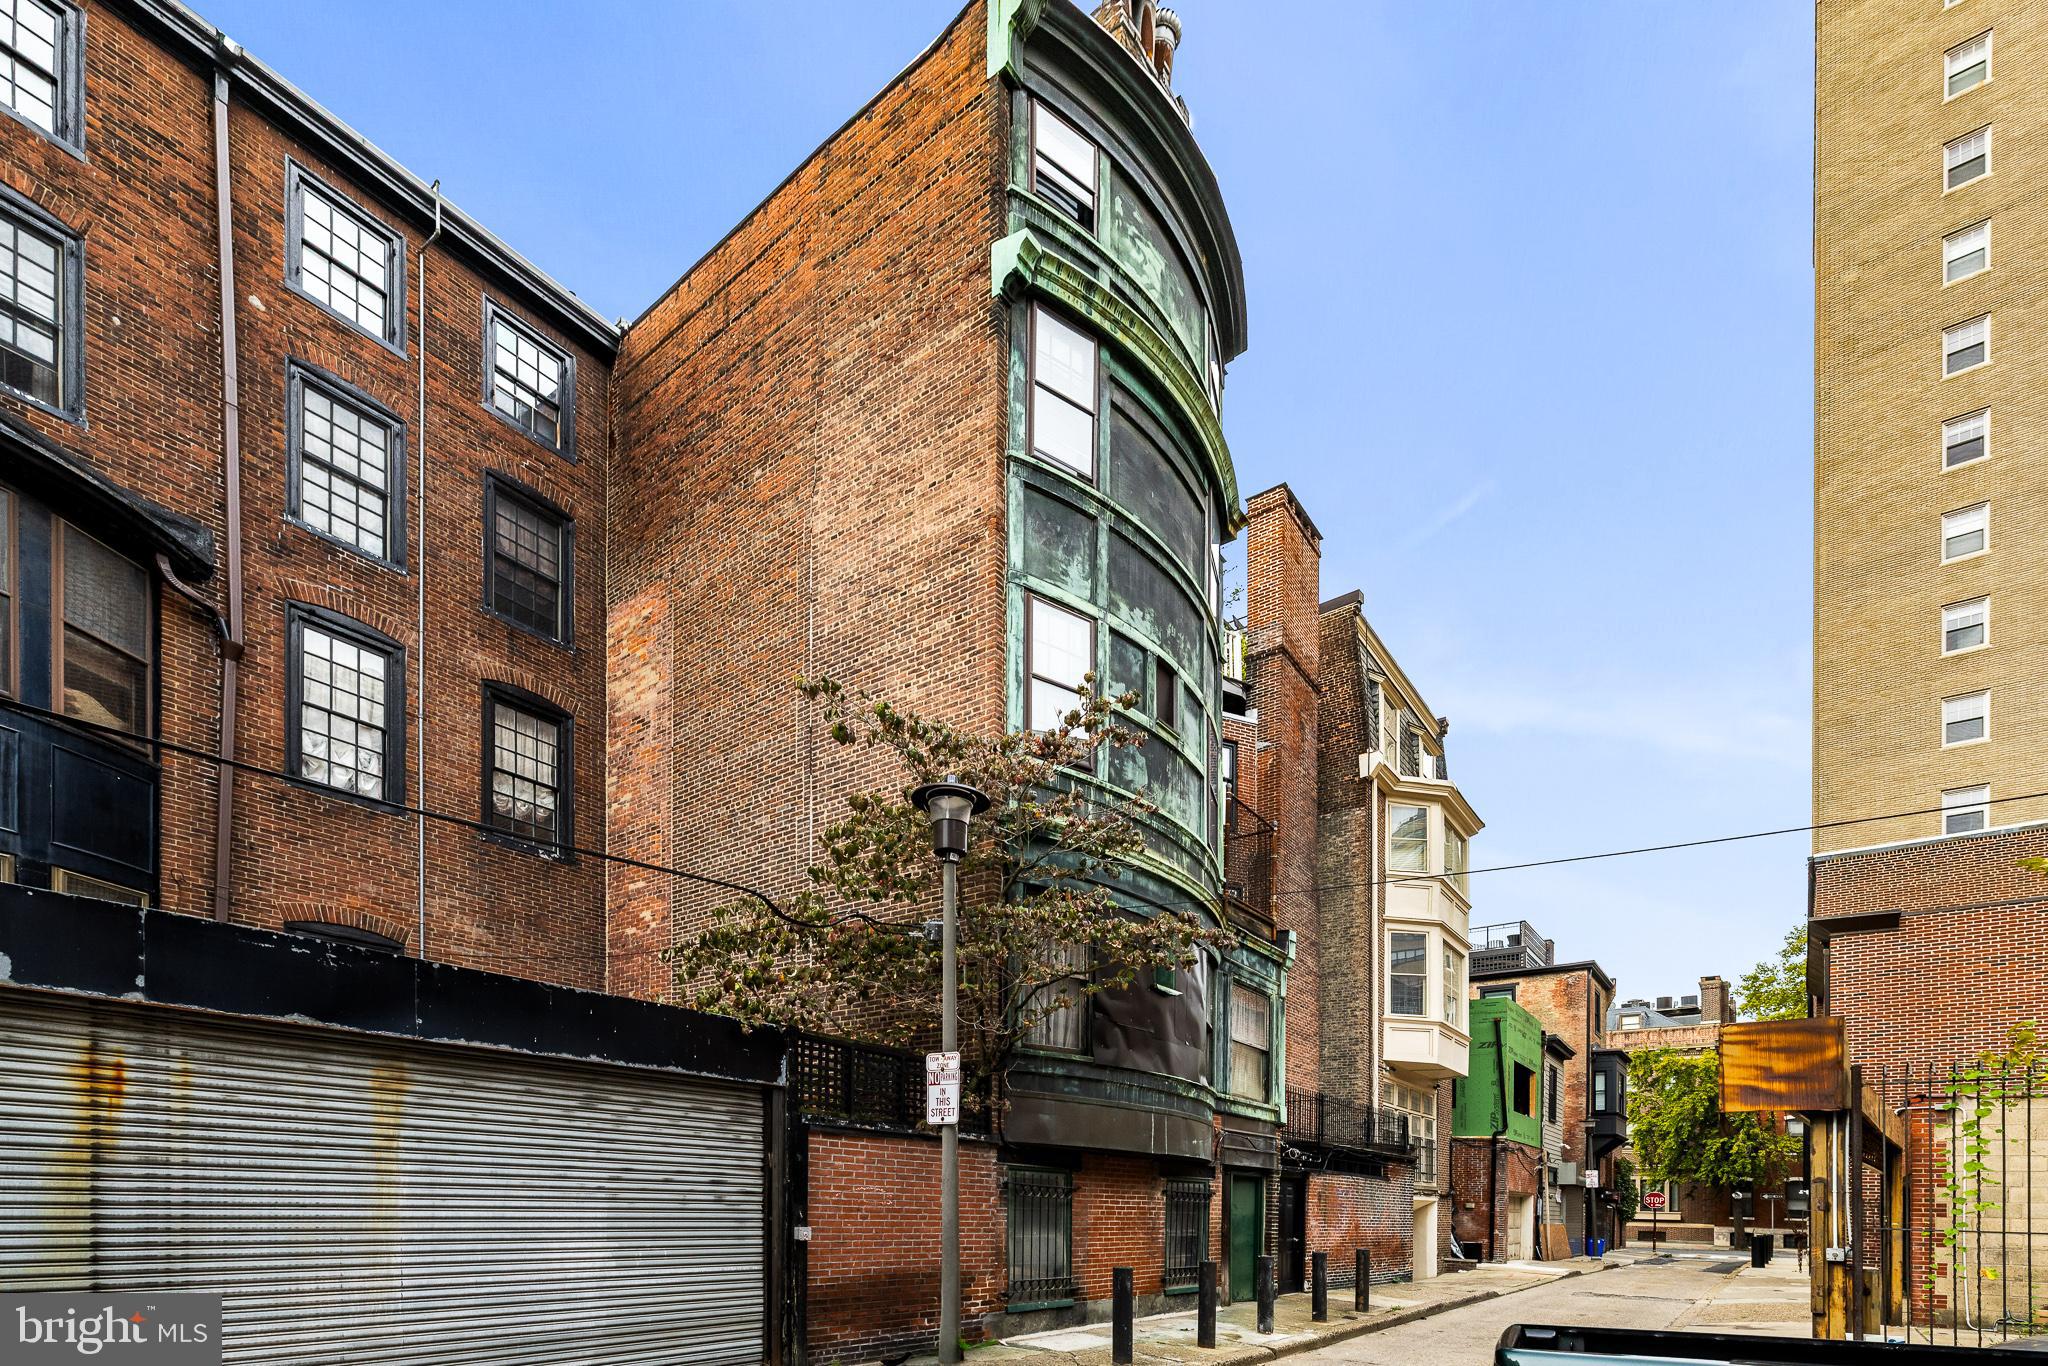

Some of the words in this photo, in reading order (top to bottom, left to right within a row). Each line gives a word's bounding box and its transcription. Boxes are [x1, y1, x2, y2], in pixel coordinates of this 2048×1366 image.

[929, 1072, 940, 1084] NO
[940, 1072, 958, 1080] PARKING
[936, 1097, 950, 1106] THIS
[931, 1108, 955, 1117] STREET
[1645, 1196, 1665, 1204] STOP
